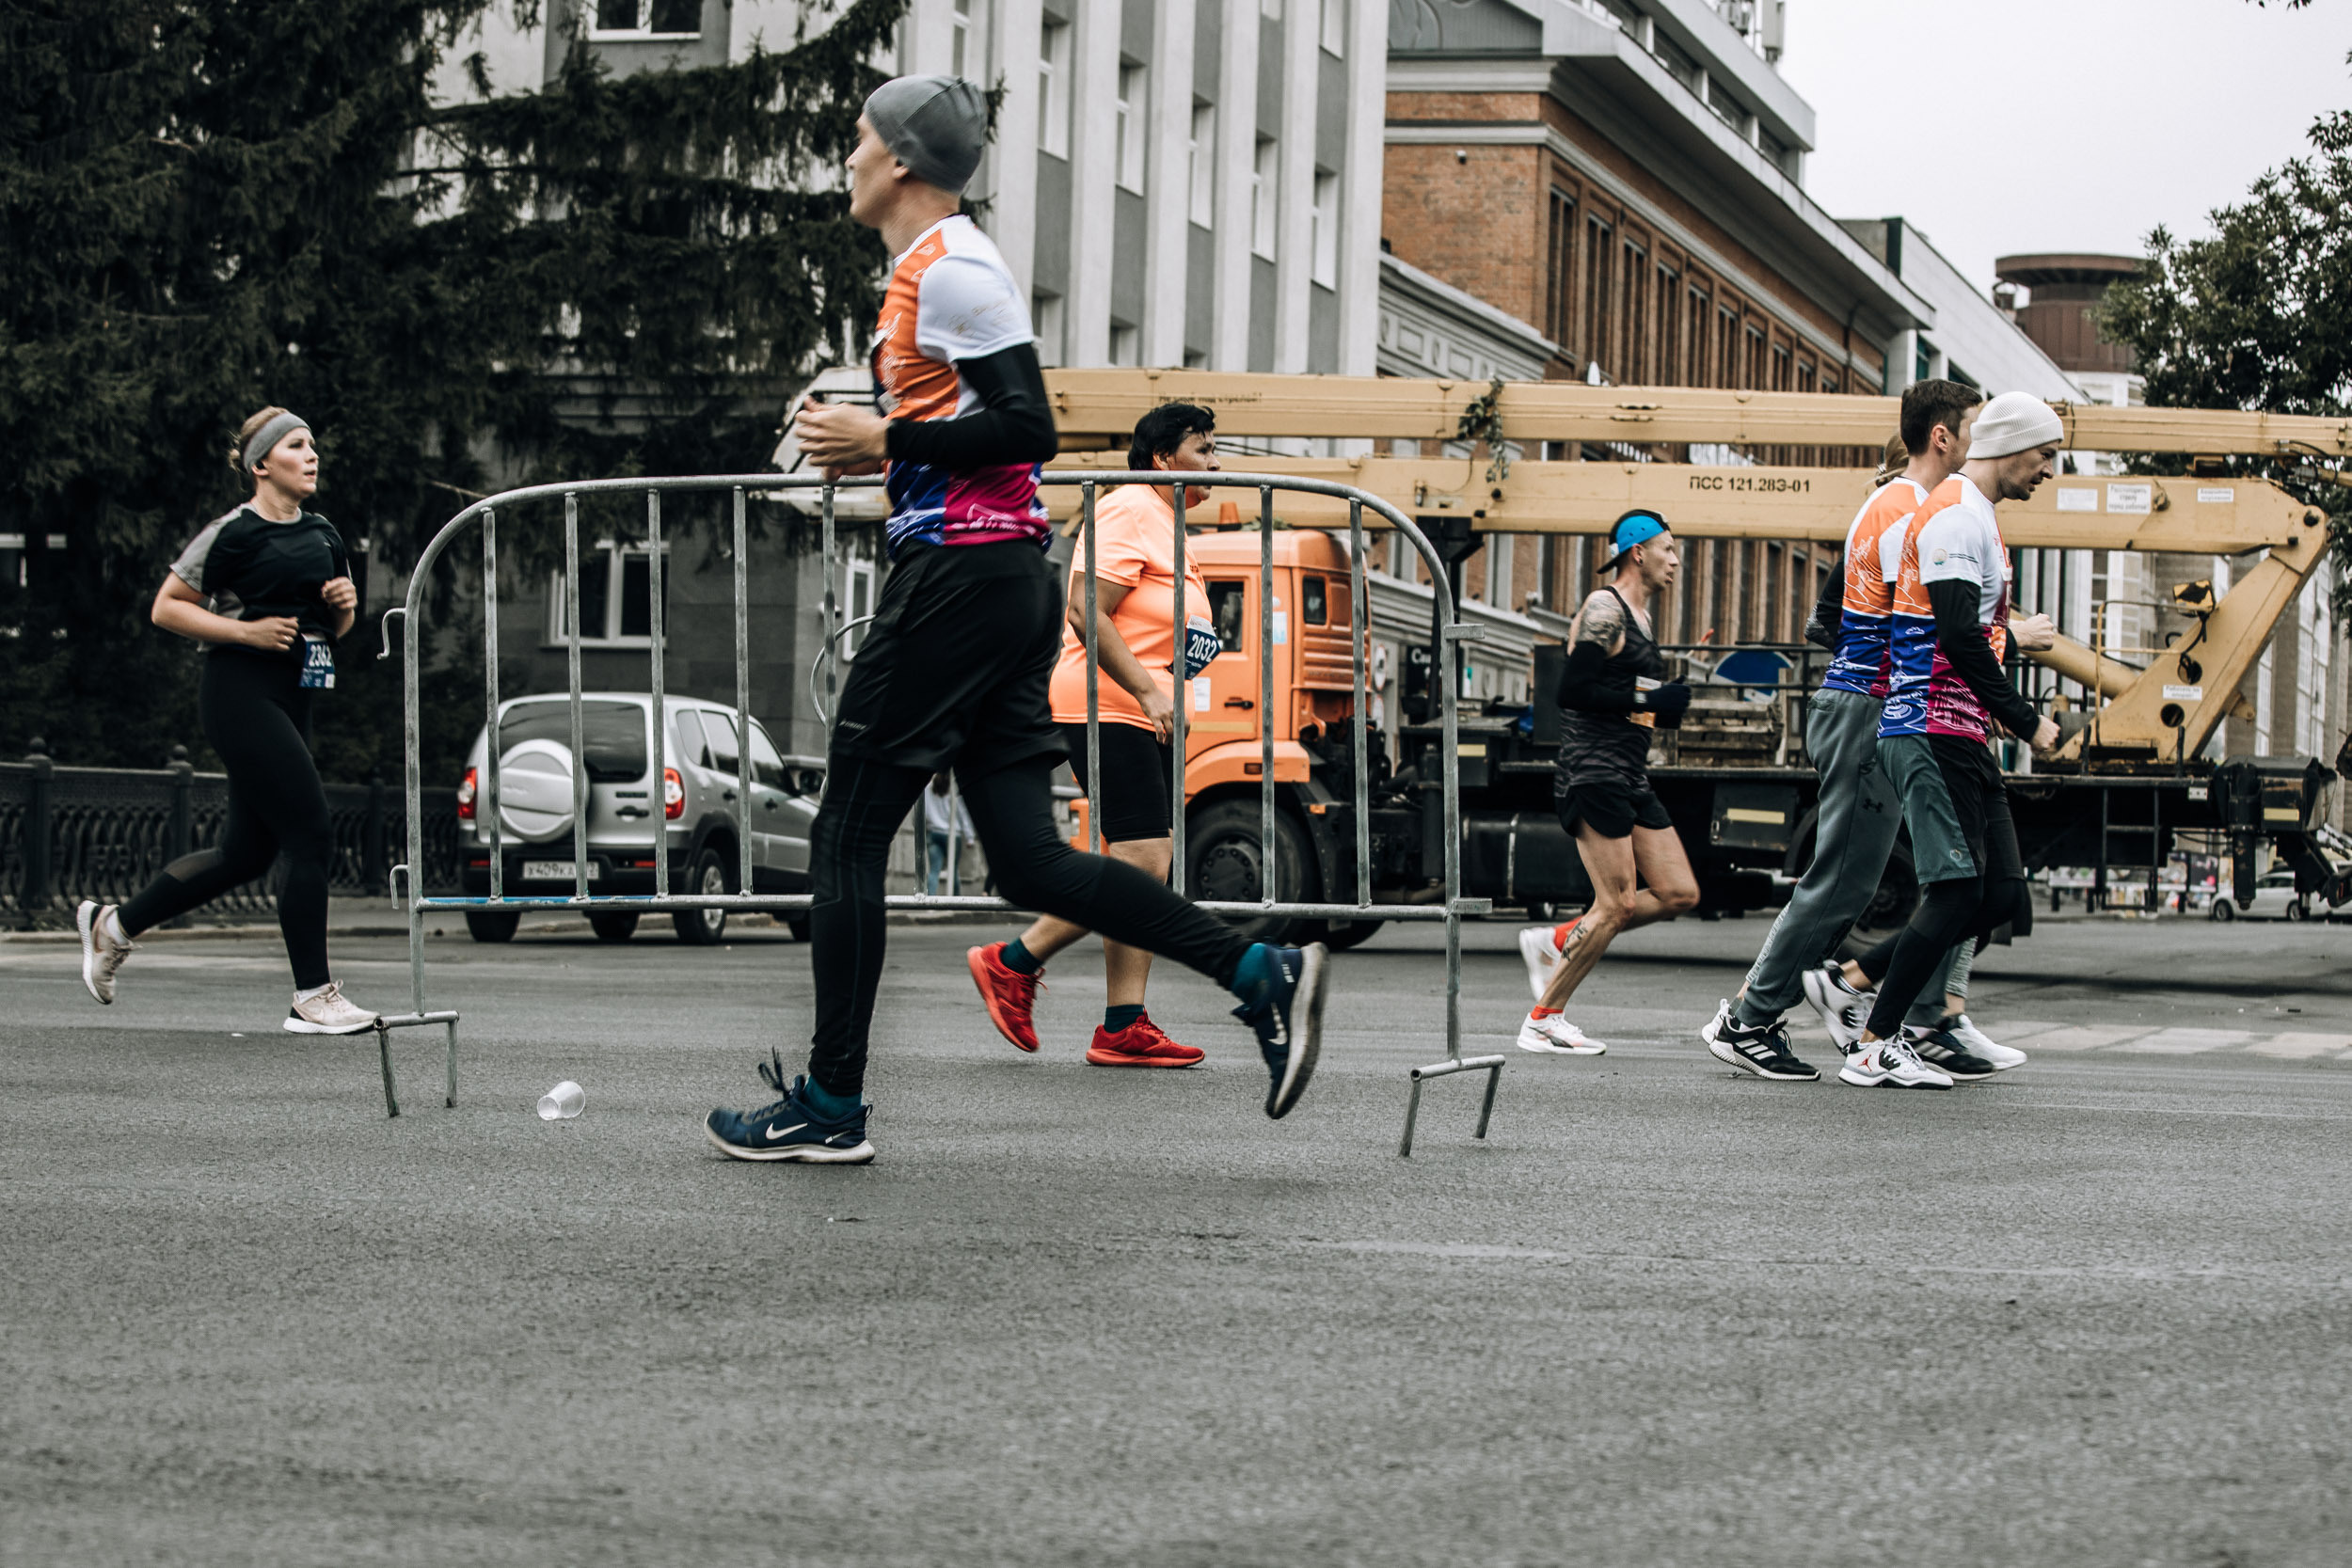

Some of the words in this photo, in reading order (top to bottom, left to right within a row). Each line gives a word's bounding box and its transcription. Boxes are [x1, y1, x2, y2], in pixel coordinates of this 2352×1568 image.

[1690, 476, 1723, 490] ПСС
[309, 643, 333, 667] 2362
[1186, 633, 1217, 663] 2032
